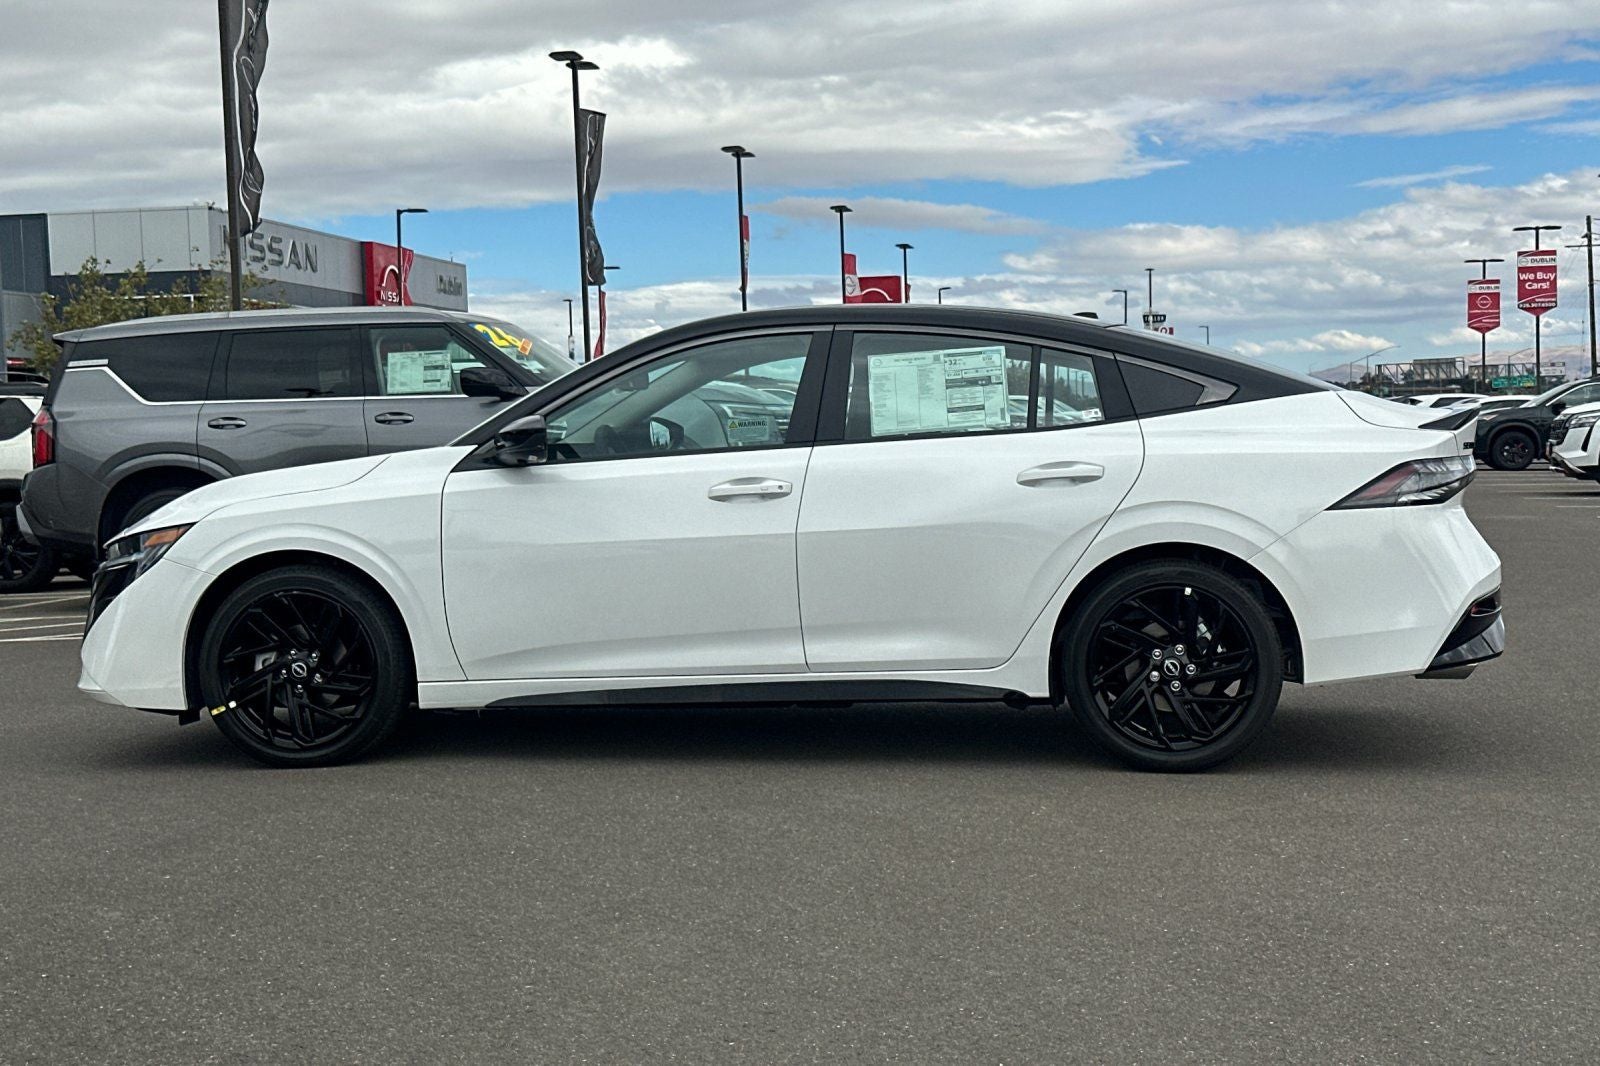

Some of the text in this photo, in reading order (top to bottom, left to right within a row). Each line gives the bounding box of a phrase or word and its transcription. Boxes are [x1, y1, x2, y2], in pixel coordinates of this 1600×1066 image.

[1519, 272, 1556, 281] We Buy
[1525, 281, 1550, 290] Cars!
